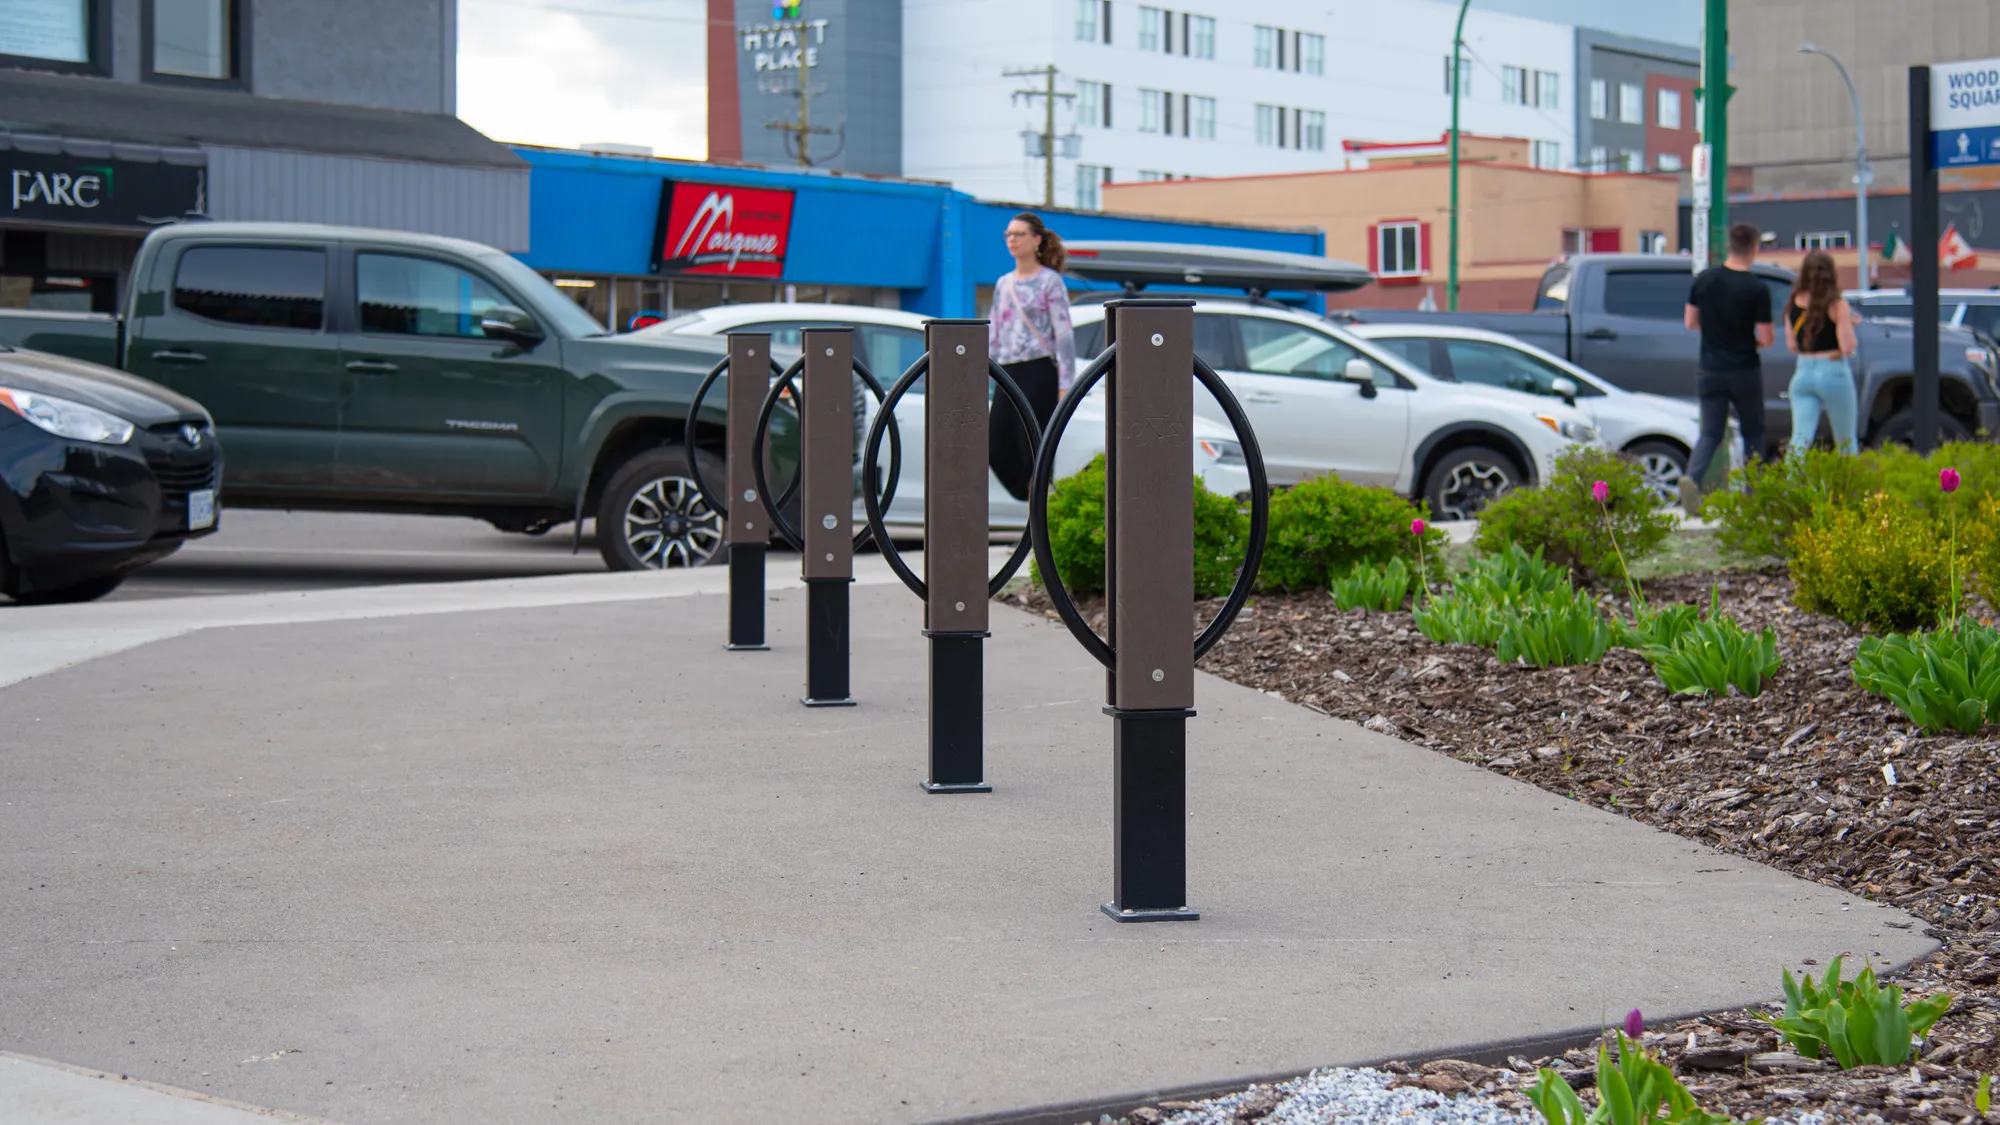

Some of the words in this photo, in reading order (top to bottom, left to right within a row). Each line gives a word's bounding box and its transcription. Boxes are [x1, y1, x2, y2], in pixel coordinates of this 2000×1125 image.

[755, 47, 818, 71] PLACE
[673, 191, 779, 272] Marquee
[445, 419, 518, 431] TACOMA
